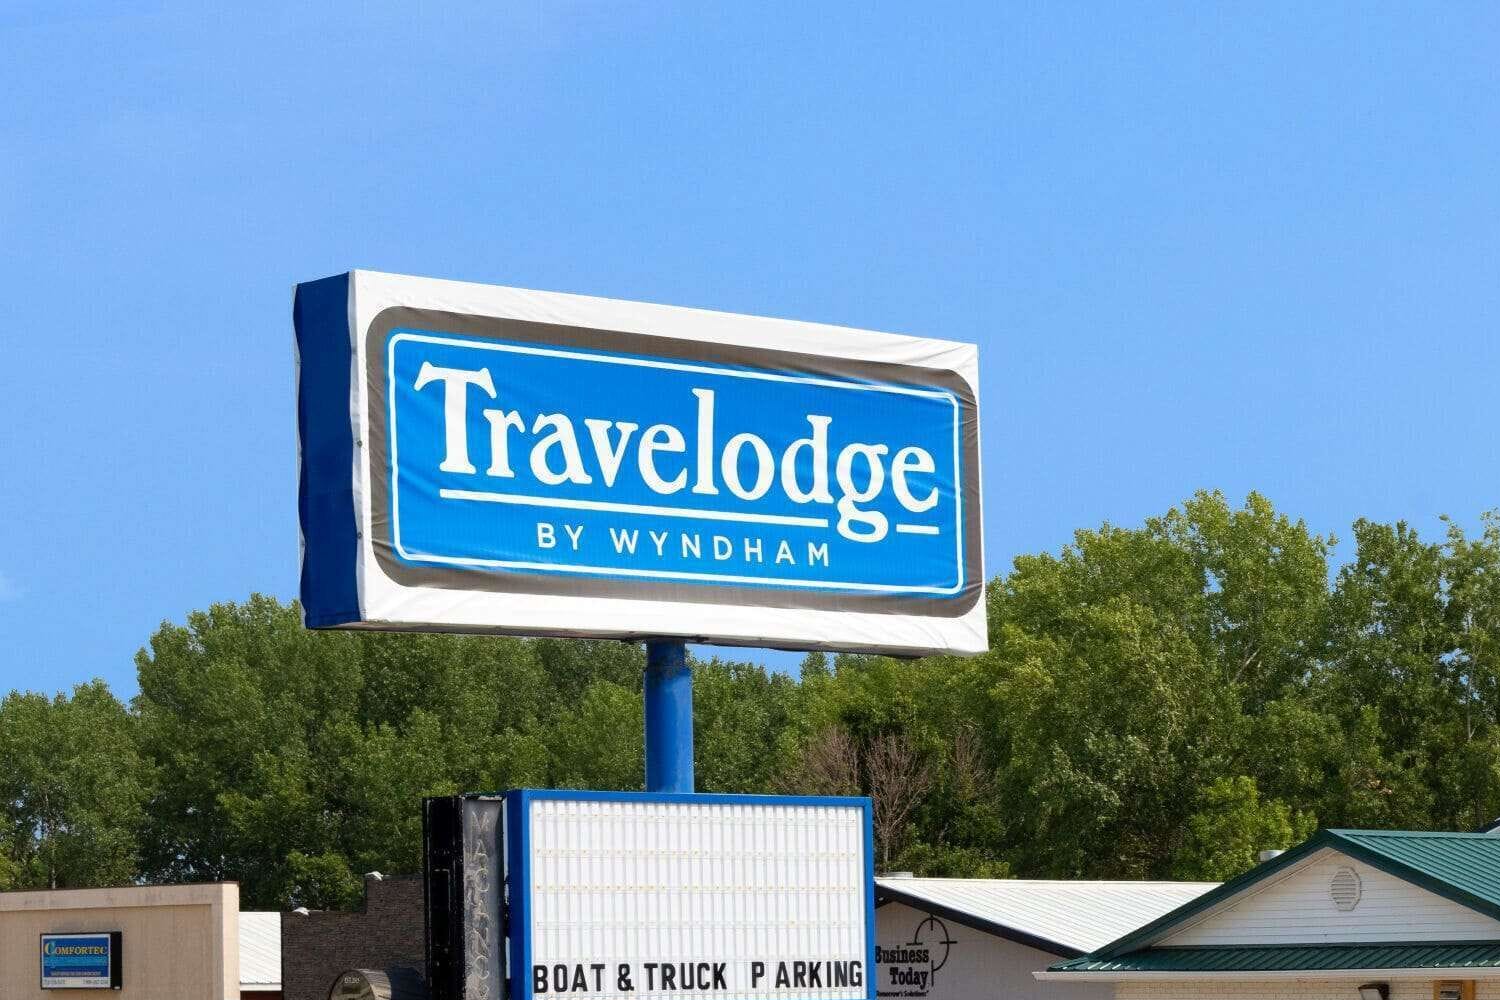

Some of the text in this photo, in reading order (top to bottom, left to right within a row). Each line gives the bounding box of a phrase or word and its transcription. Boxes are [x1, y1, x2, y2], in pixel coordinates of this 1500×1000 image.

[415, 361, 939, 543] Travelodge
[537, 523, 829, 567] BY WYNDHAM
[876, 945, 930, 964] Business
[534, 964, 606, 993] BOAT
[618, 963, 635, 991] &
[643, 962, 727, 990] TRUCK
[889, 966, 929, 990] Today
